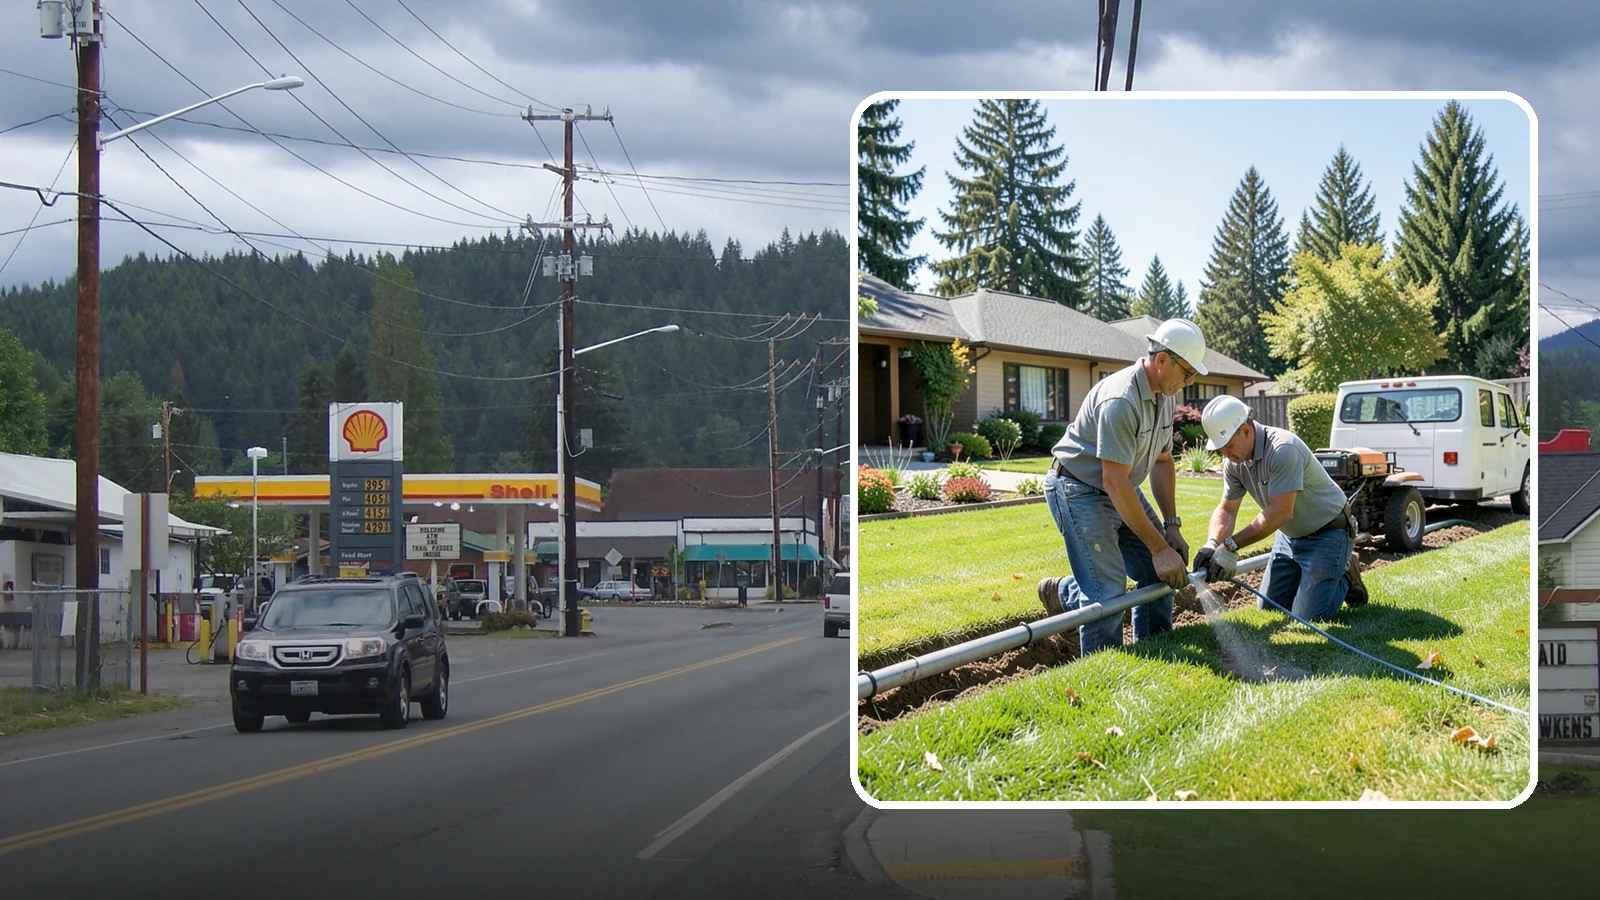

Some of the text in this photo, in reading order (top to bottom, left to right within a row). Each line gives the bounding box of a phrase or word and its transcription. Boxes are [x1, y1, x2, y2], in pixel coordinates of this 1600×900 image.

[366, 480, 383, 490] 395
[490, 484, 548, 498] Shell
[365, 494, 383, 504] 405
[365, 508, 383, 518] 415
[365, 522, 383, 532] 429
[1539, 643, 1566, 665] AID
